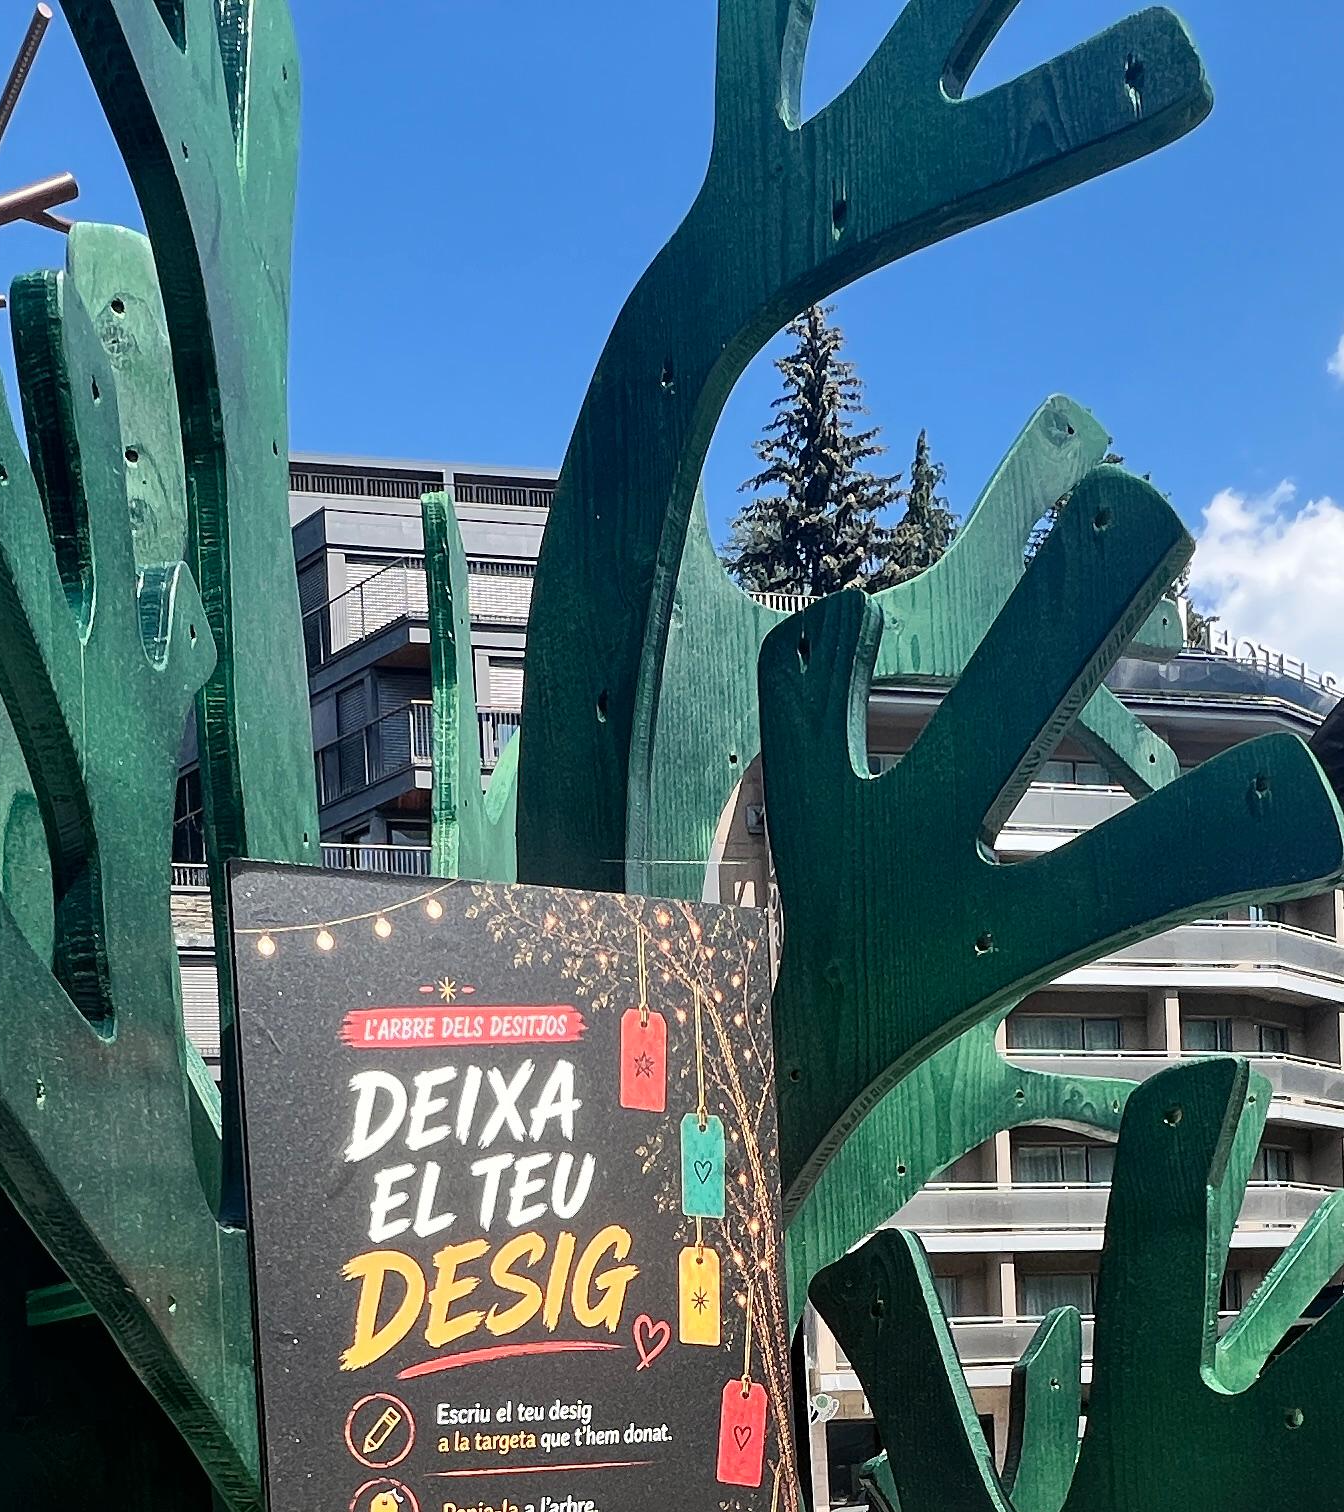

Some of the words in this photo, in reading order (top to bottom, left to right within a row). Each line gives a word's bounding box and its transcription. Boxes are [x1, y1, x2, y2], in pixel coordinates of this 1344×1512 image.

[364, 1017, 436, 1041] L'ARBRE
[441, 1015, 483, 1038] DELS
[490, 1014, 568, 1037] DESITJOS
[342, 1059, 582, 1163] DEIXA
[367, 1161, 457, 1244] EL
[470, 1151, 596, 1230] TEU
[338, 1225, 639, 1372] DESIG
[436, 1403, 491, 1425] Escriu
[496, 1400, 512, 1423] el
[517, 1402, 545, 1422] teu
[549, 1399, 592, 1424] desig
[438, 1437, 449, 1452] a
[454, 1431, 470, 1452] la
[475, 1430, 536, 1455] targeta
[541, 1432, 570, 1452] que
[574, 1425, 620, 1446] t'hem
[623, 1423, 673, 1443] donat.
